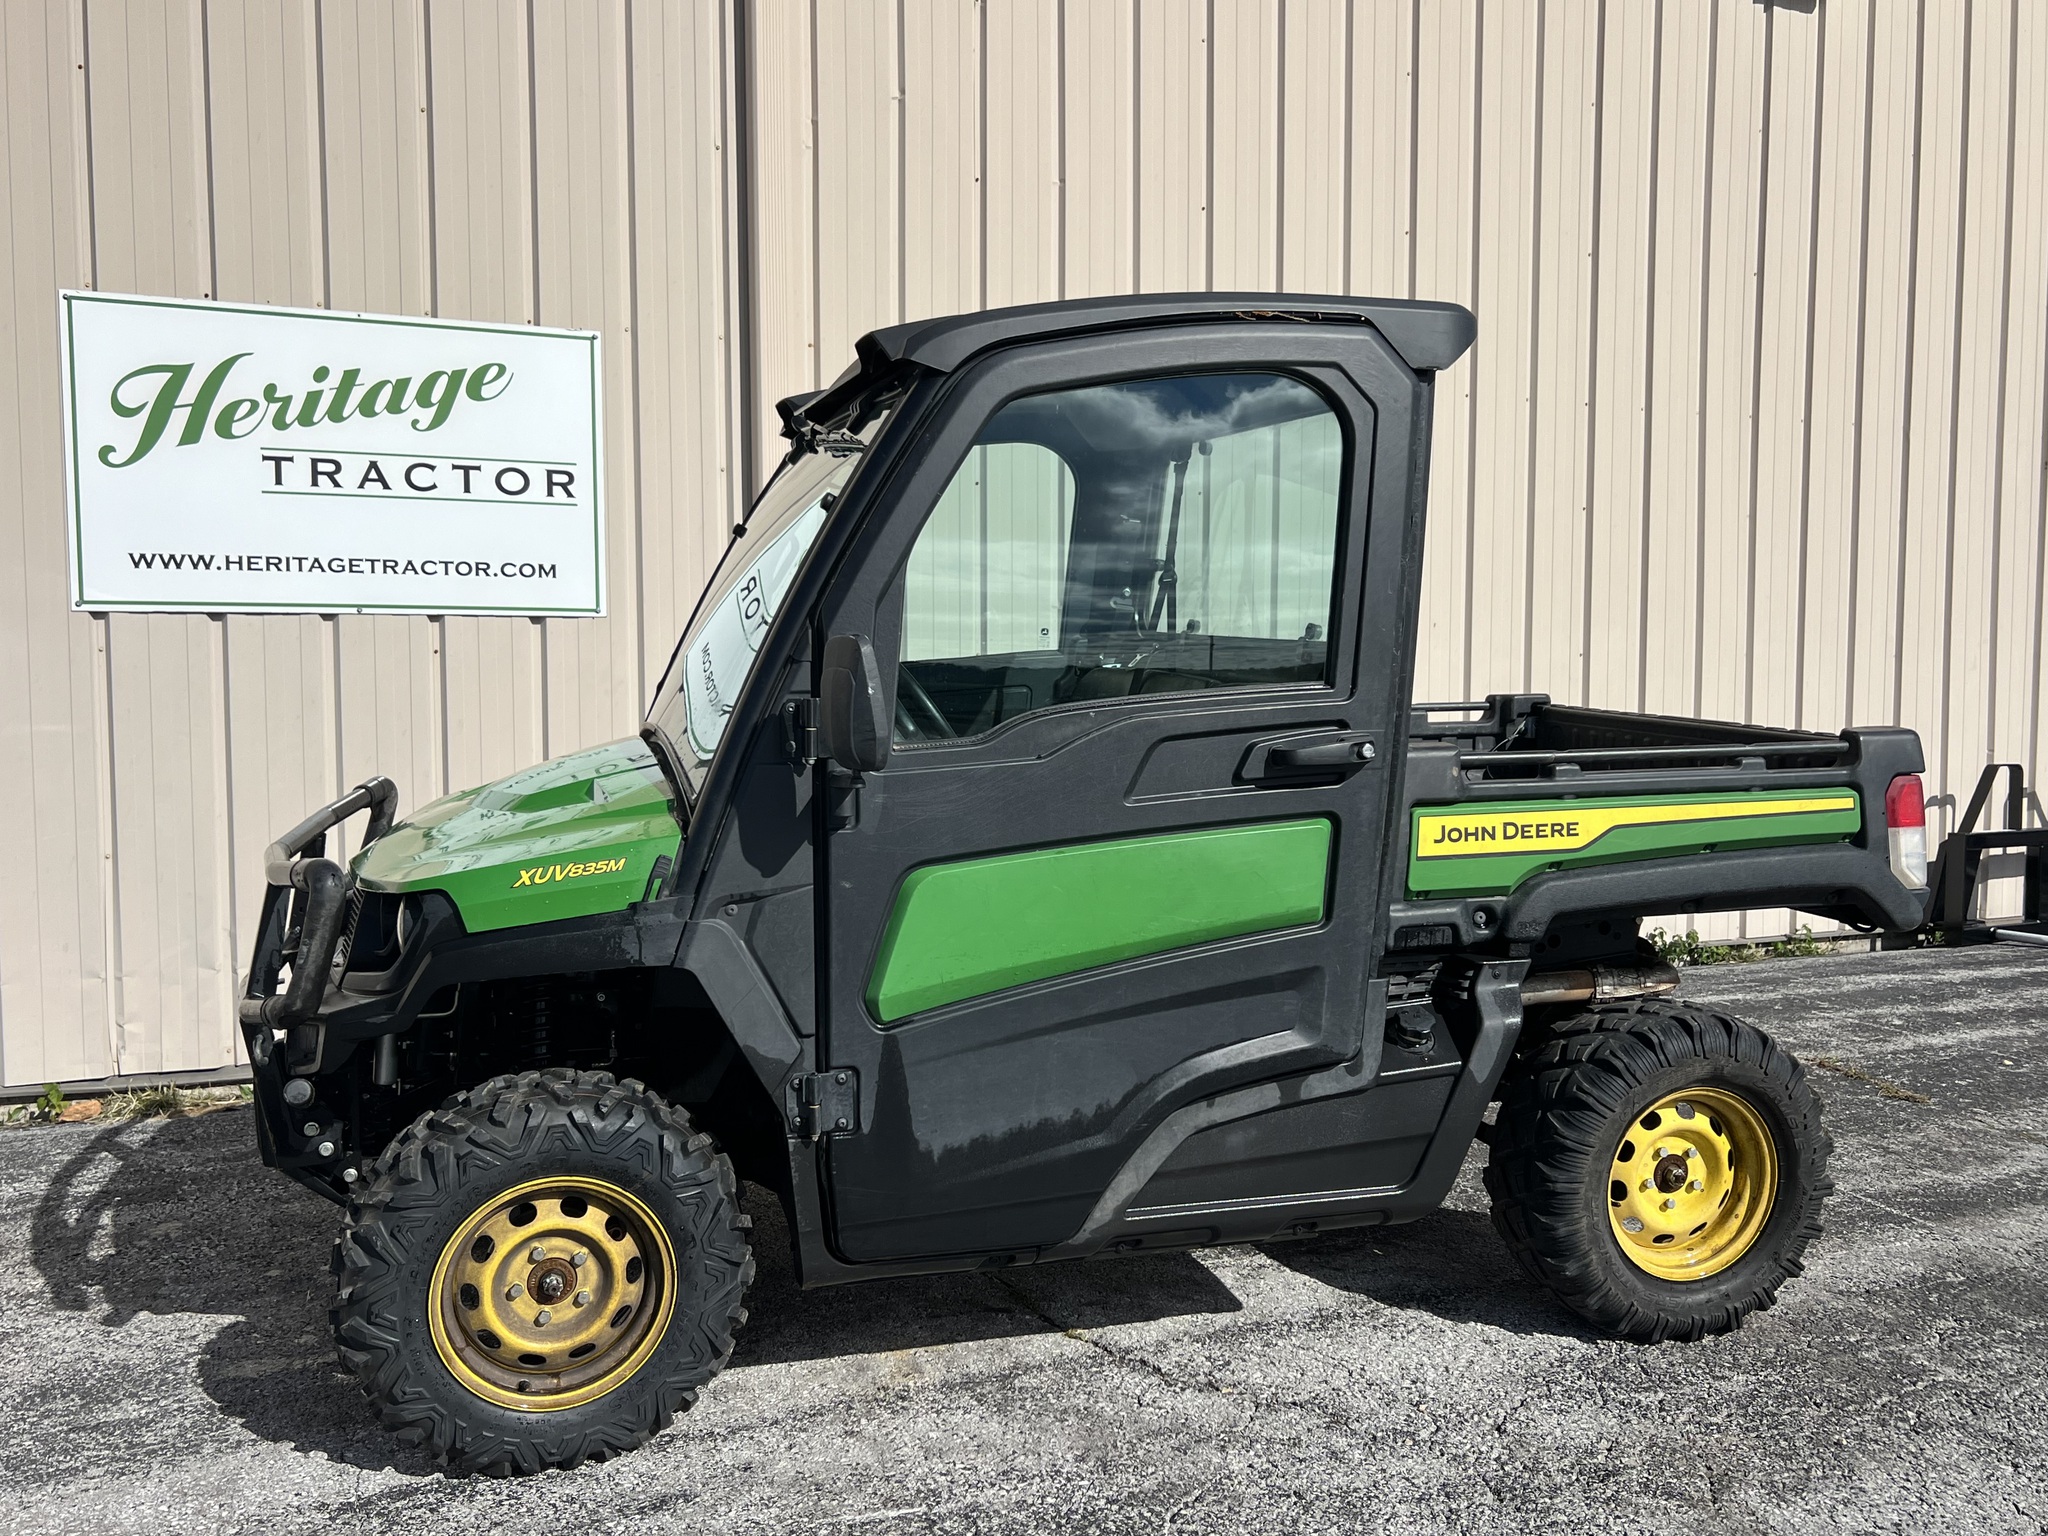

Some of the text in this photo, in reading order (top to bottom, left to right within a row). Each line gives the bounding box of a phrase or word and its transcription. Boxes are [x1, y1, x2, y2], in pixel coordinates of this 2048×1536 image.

[98, 352, 514, 468] Heritage
[261, 454, 576, 499] TRACTOR
[128, 552, 557, 579] WWW.HERITAGETRACTOR.COM
[1433, 821, 1579, 844] JOHN DEERE
[510, 857, 627, 889] XUV835M
